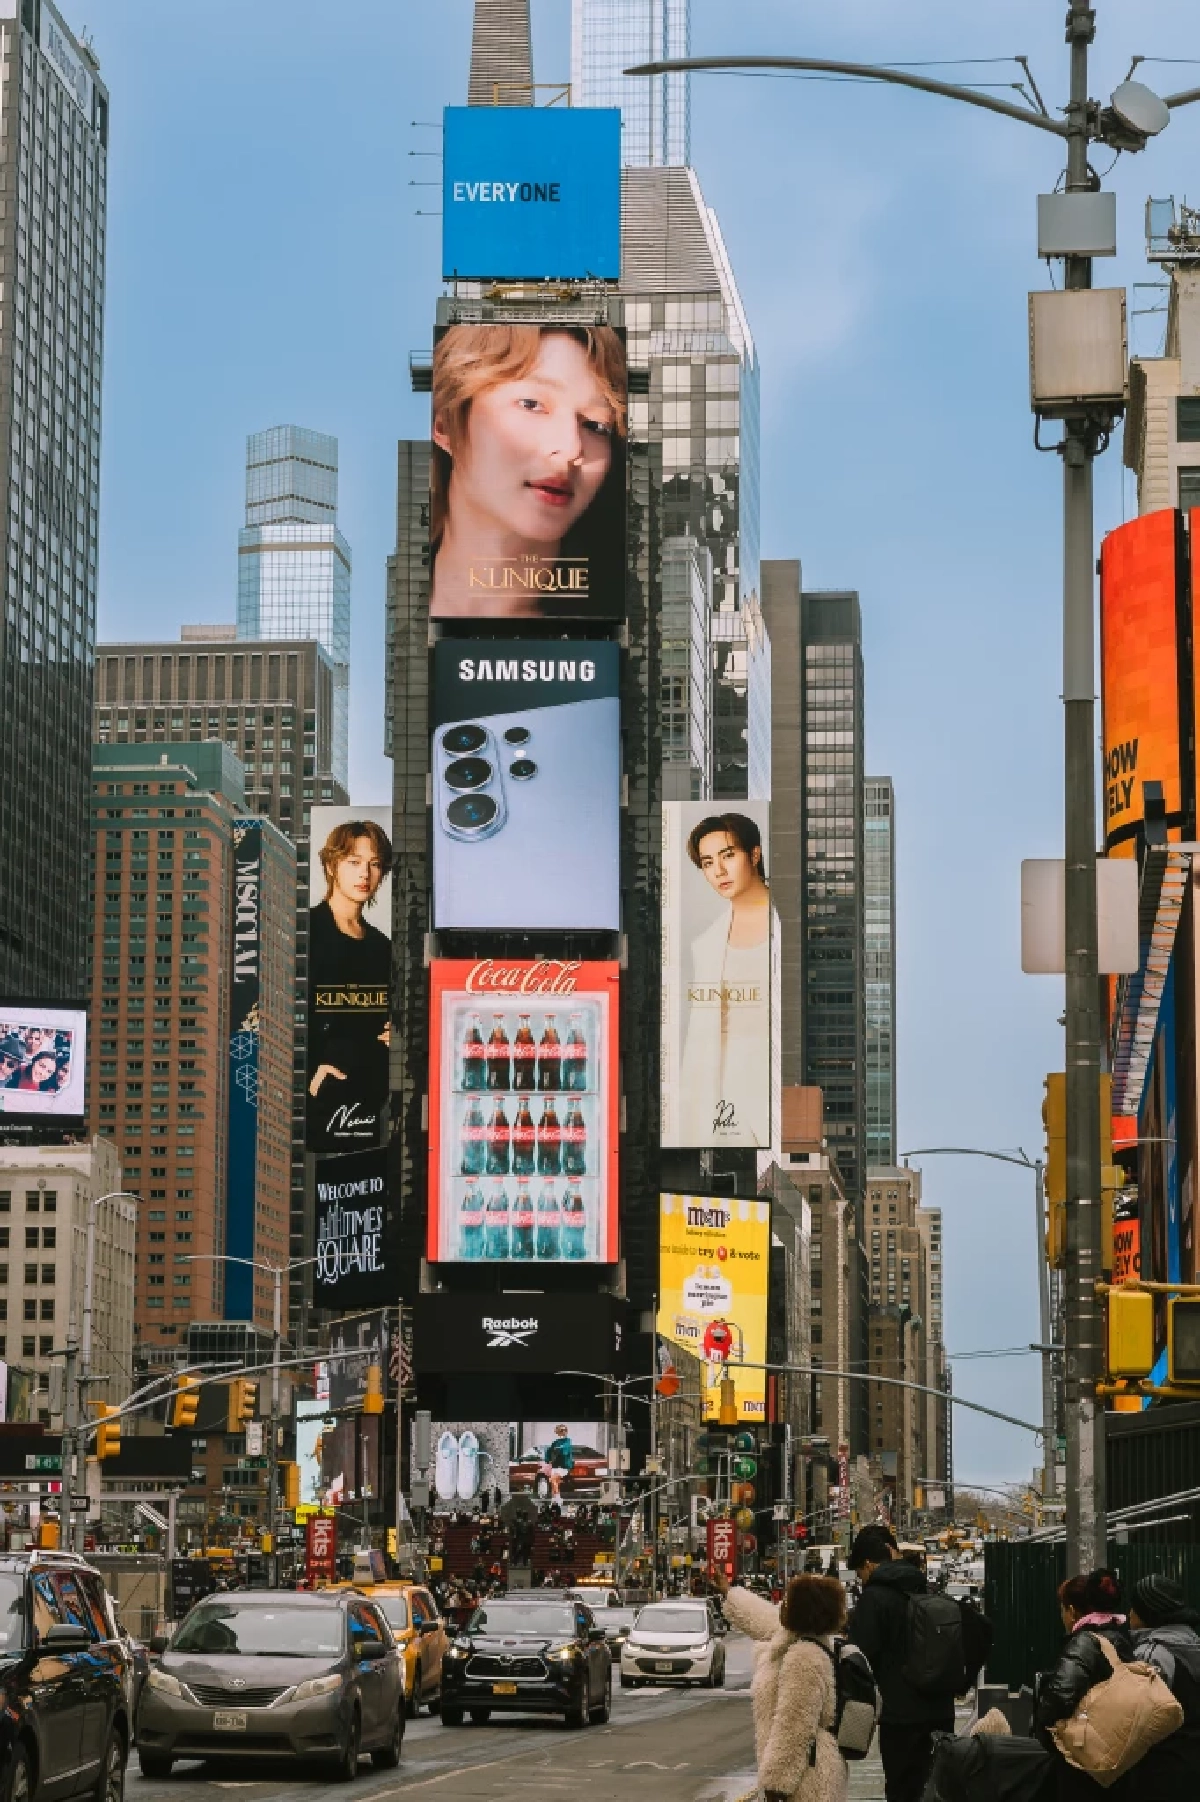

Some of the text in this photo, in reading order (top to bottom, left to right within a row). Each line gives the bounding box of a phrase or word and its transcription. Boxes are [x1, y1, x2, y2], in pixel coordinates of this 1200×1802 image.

[453, 182, 561, 202] EVERYONE
[469, 567, 589, 591] KLINIQUE
[459, 659, 596, 682] SAMSUNG
[465, 959, 582, 996] Coca-Cola
[315, 992, 388, 1007] KLINIQUE
[687, 988, 762, 1002] KLINIQUE
[318, 1177, 384, 1202] WELCOME TO
[482, 1317, 539, 1330] Reebok
[313, 1519, 332, 1557] tkts
[714, 1522, 732, 1559] tkts
